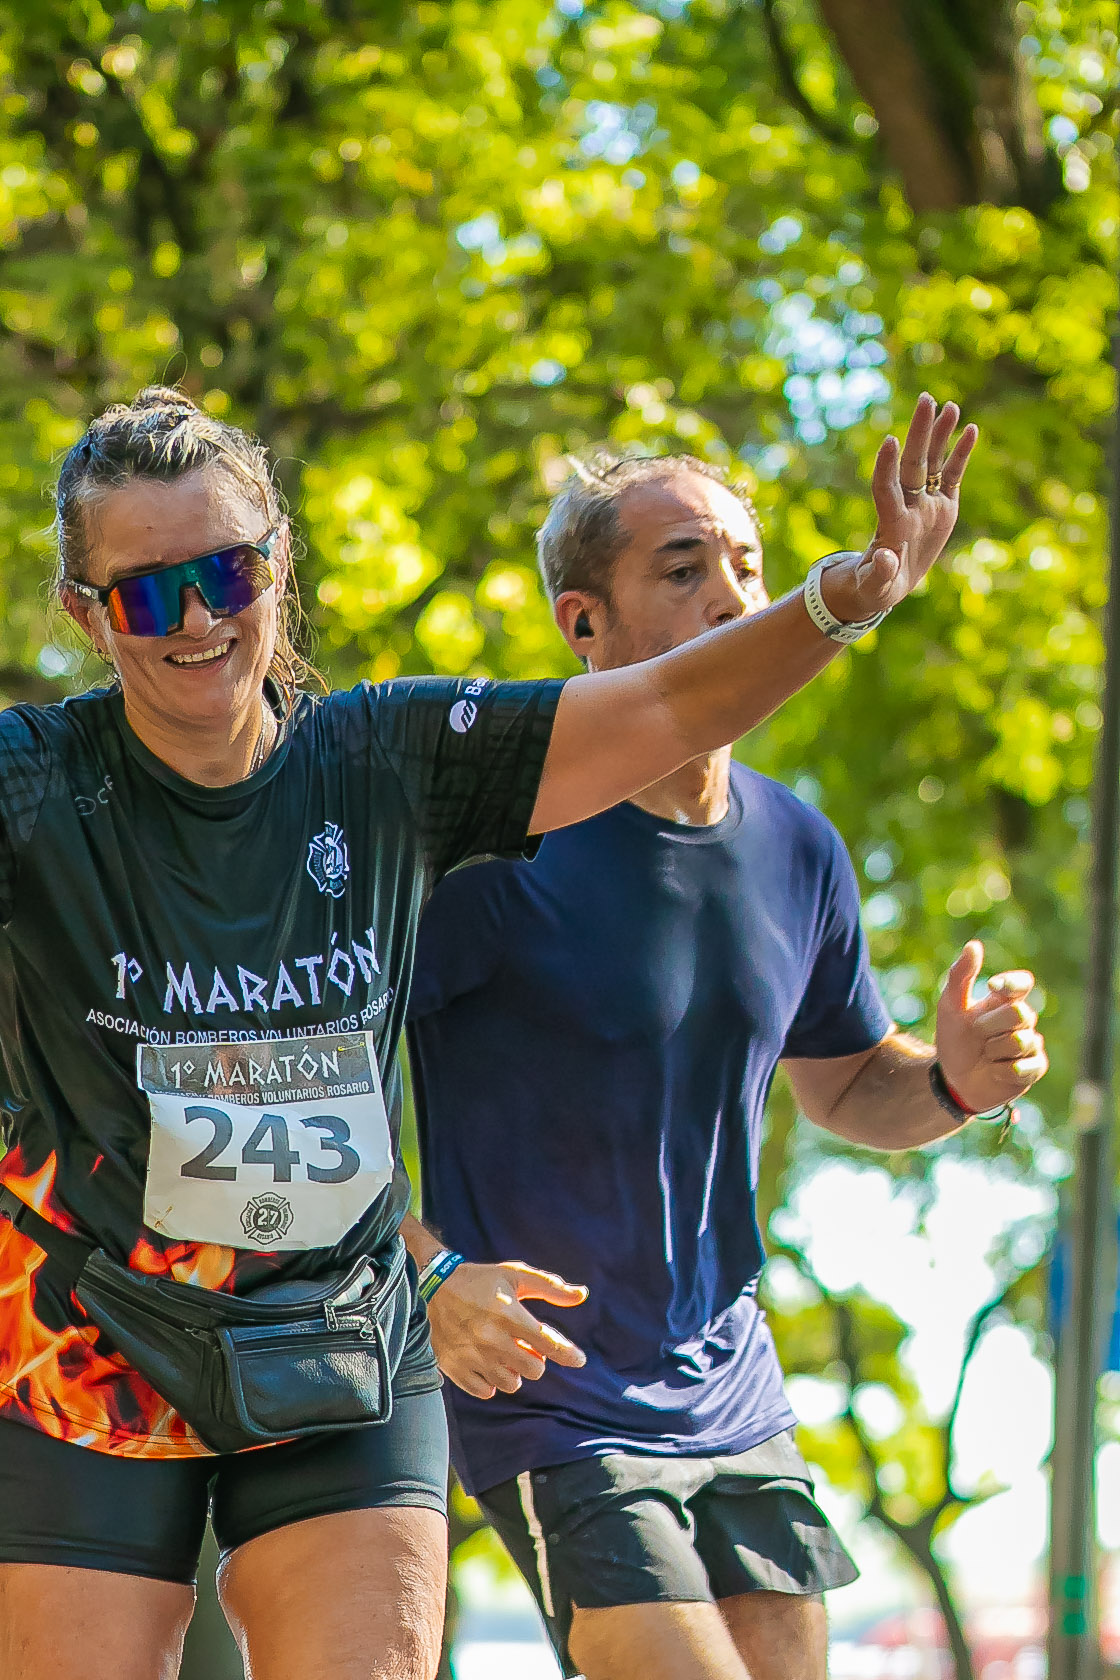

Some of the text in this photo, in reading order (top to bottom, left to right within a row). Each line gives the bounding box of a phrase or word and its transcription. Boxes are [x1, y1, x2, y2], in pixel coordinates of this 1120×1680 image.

[163, 926, 381, 1014] MARATÓN
[86, 987, 394, 1045] ASOCIACIÓN BOMBEROS VOLUNTARIOS ROSARO
[203, 1044, 341, 1088] MARATÓN
[261, 1086, 324, 1104] VOLUNTARIOS
[326, 1080, 370, 1097] ROSARIO
[181, 1105, 361, 1184] 243
[257, 1207, 279, 1226] 27
